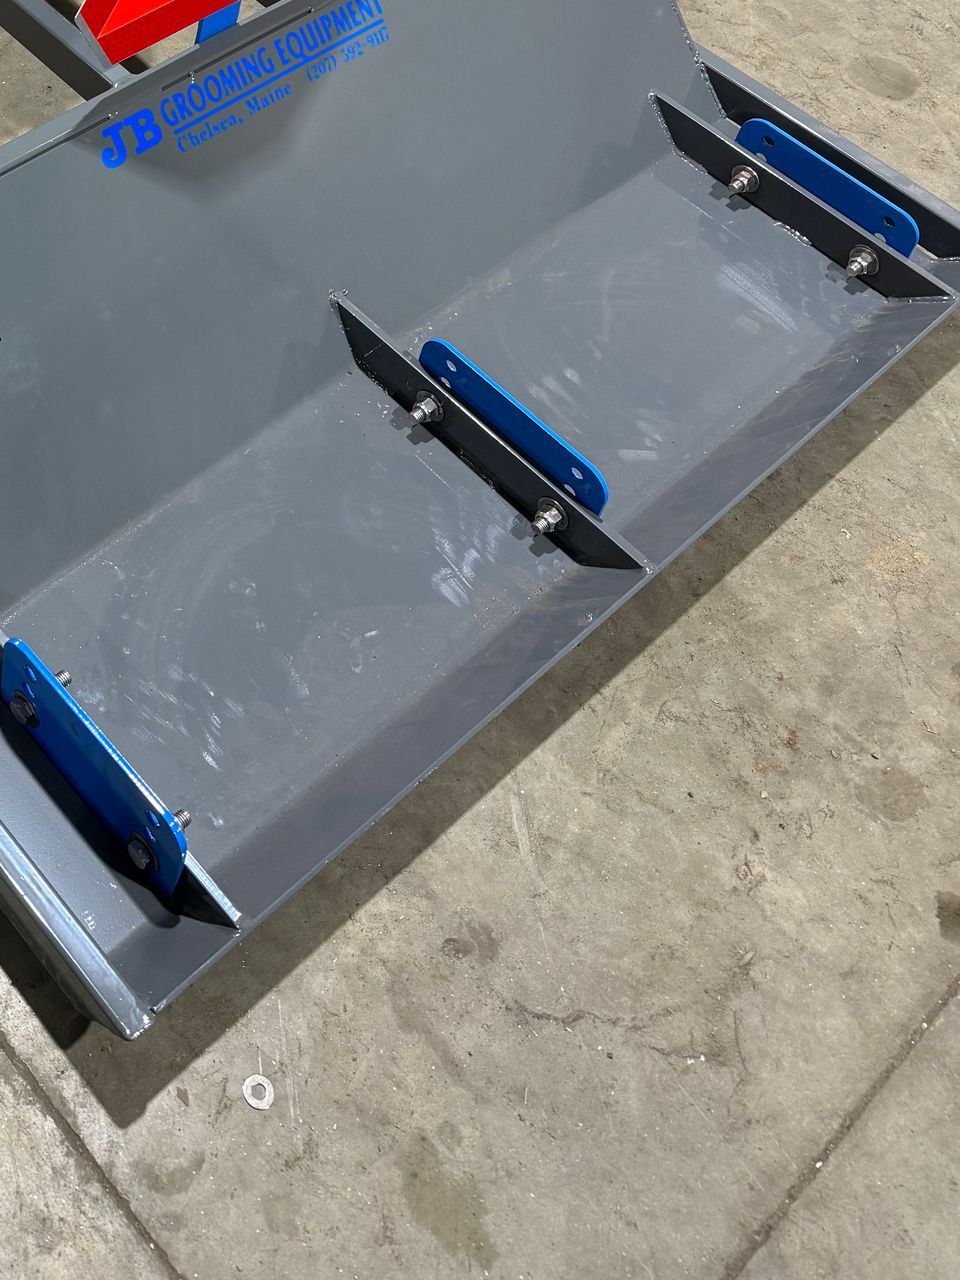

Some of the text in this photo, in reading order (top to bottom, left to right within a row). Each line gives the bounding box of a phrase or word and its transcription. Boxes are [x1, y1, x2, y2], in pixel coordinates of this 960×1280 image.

[100, 107, 163, 169] JB
[160, 47, 276, 126] GROOMING
[177, 116, 244, 153] Chelsea,
[246, 83, 291, 116] Maine
